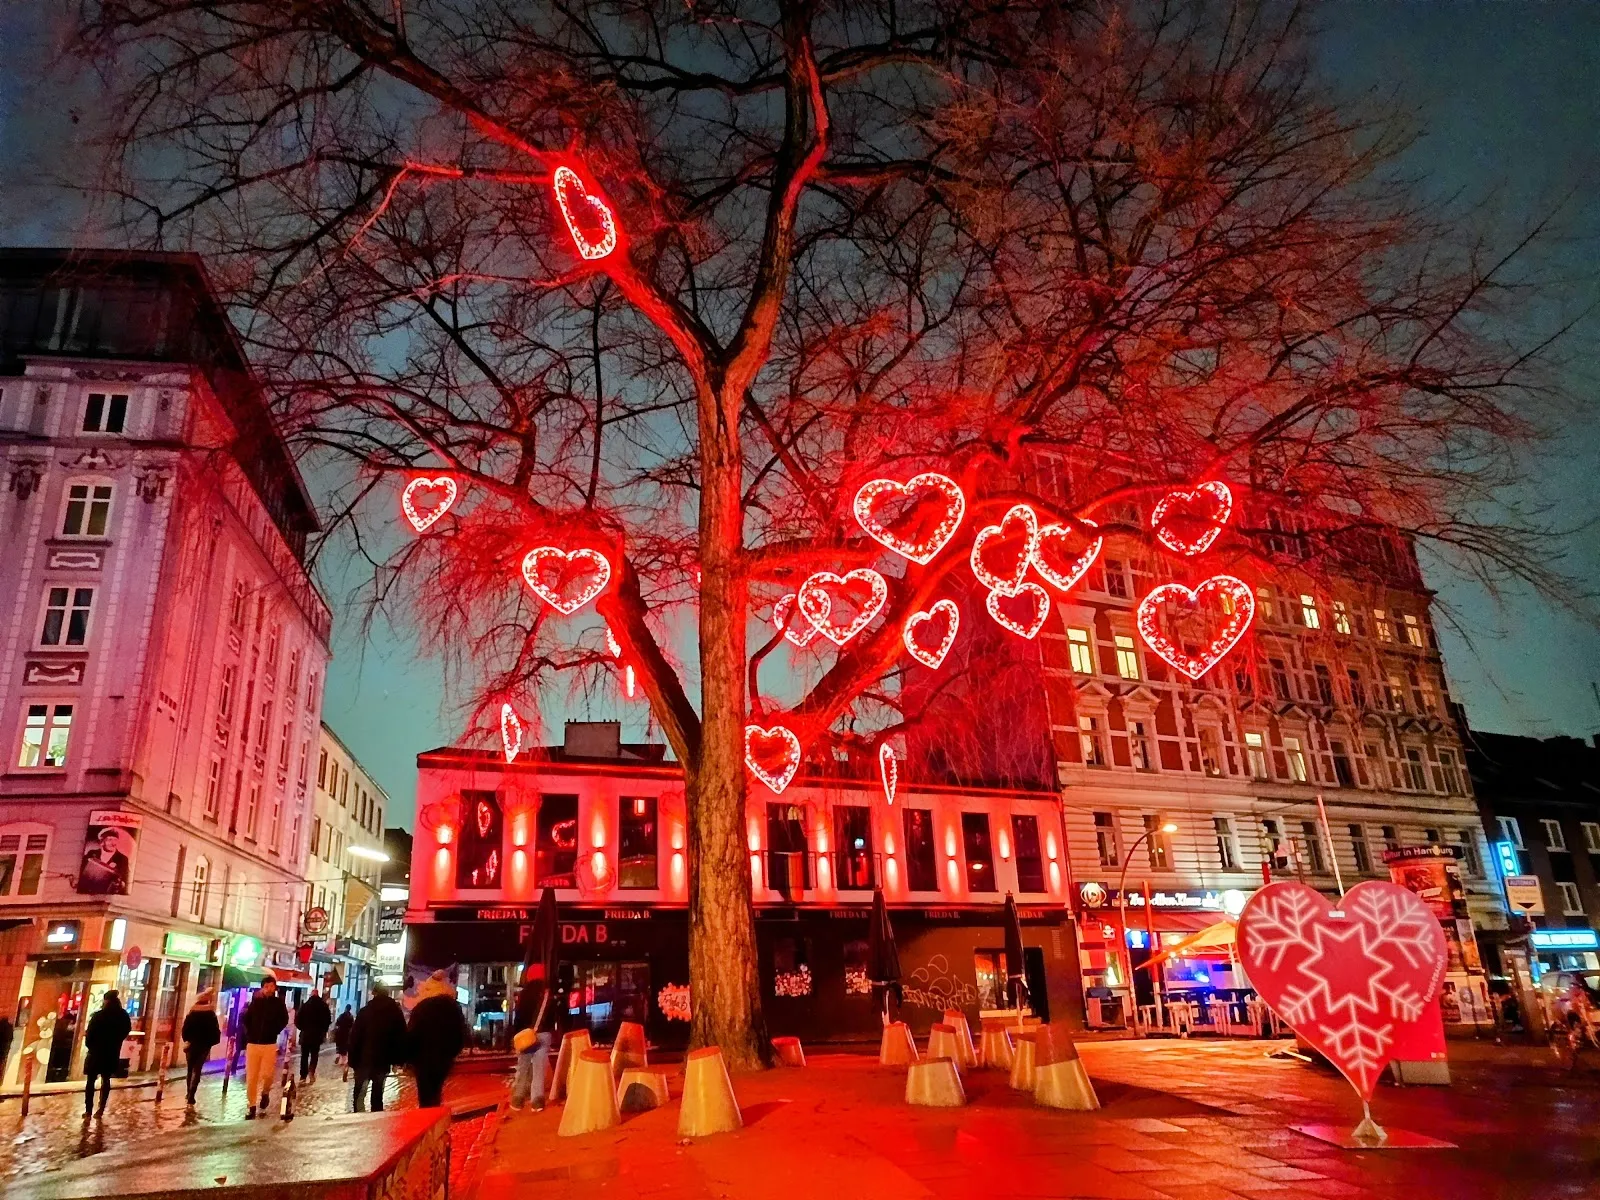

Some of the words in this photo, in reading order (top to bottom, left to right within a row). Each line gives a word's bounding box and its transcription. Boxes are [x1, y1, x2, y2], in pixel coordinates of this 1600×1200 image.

[1403, 849, 1412, 857] in
[1413, 847, 1454, 855] Hamurg
[477, 910, 518, 919] FRIEDA
[519, 910, 530, 919] B.
[604, 910, 641, 919] FRIEDA
[643, 910, 652, 919] B.
[829, 911, 860, 919] FRIEDA
